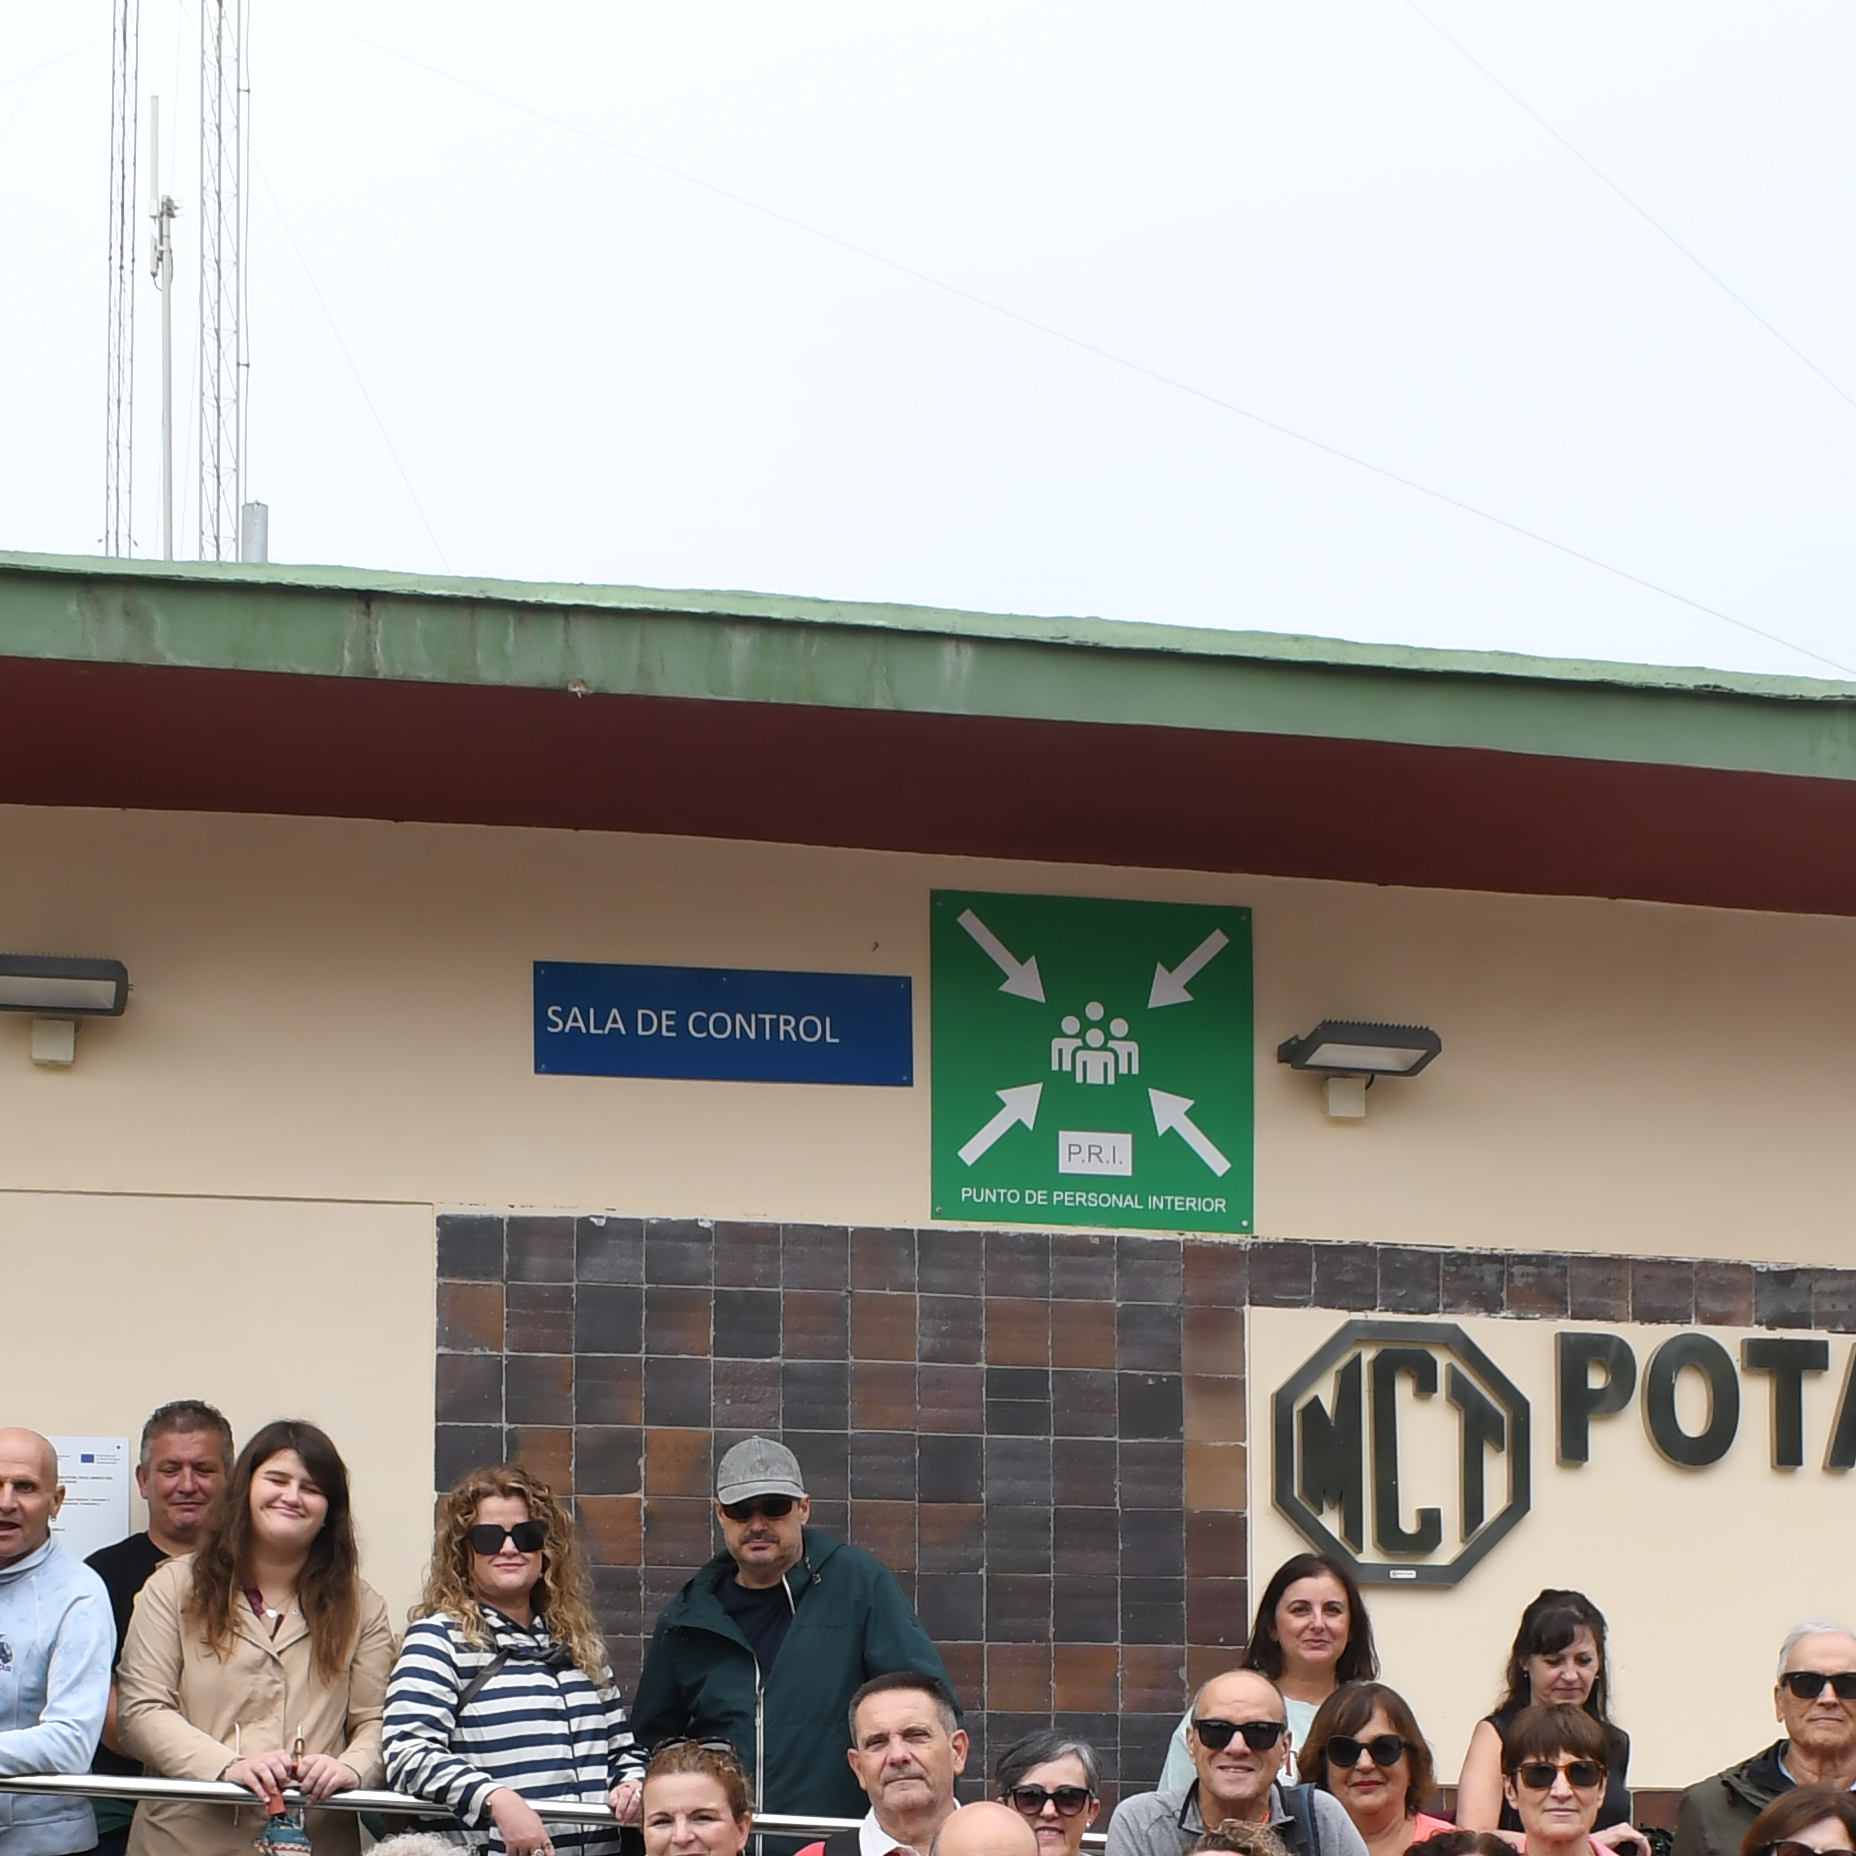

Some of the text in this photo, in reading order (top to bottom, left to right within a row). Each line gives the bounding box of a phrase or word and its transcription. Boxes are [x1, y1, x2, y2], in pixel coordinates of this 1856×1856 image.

[546, 1005, 840, 1043] SALA DE CONTROL
[1067, 1143, 1124, 1165] P.R.I.
[961, 1187, 1227, 1213] PUNTO DE PERSONAL INTERIOR
[1297, 1347, 1505, 1556] MCT
